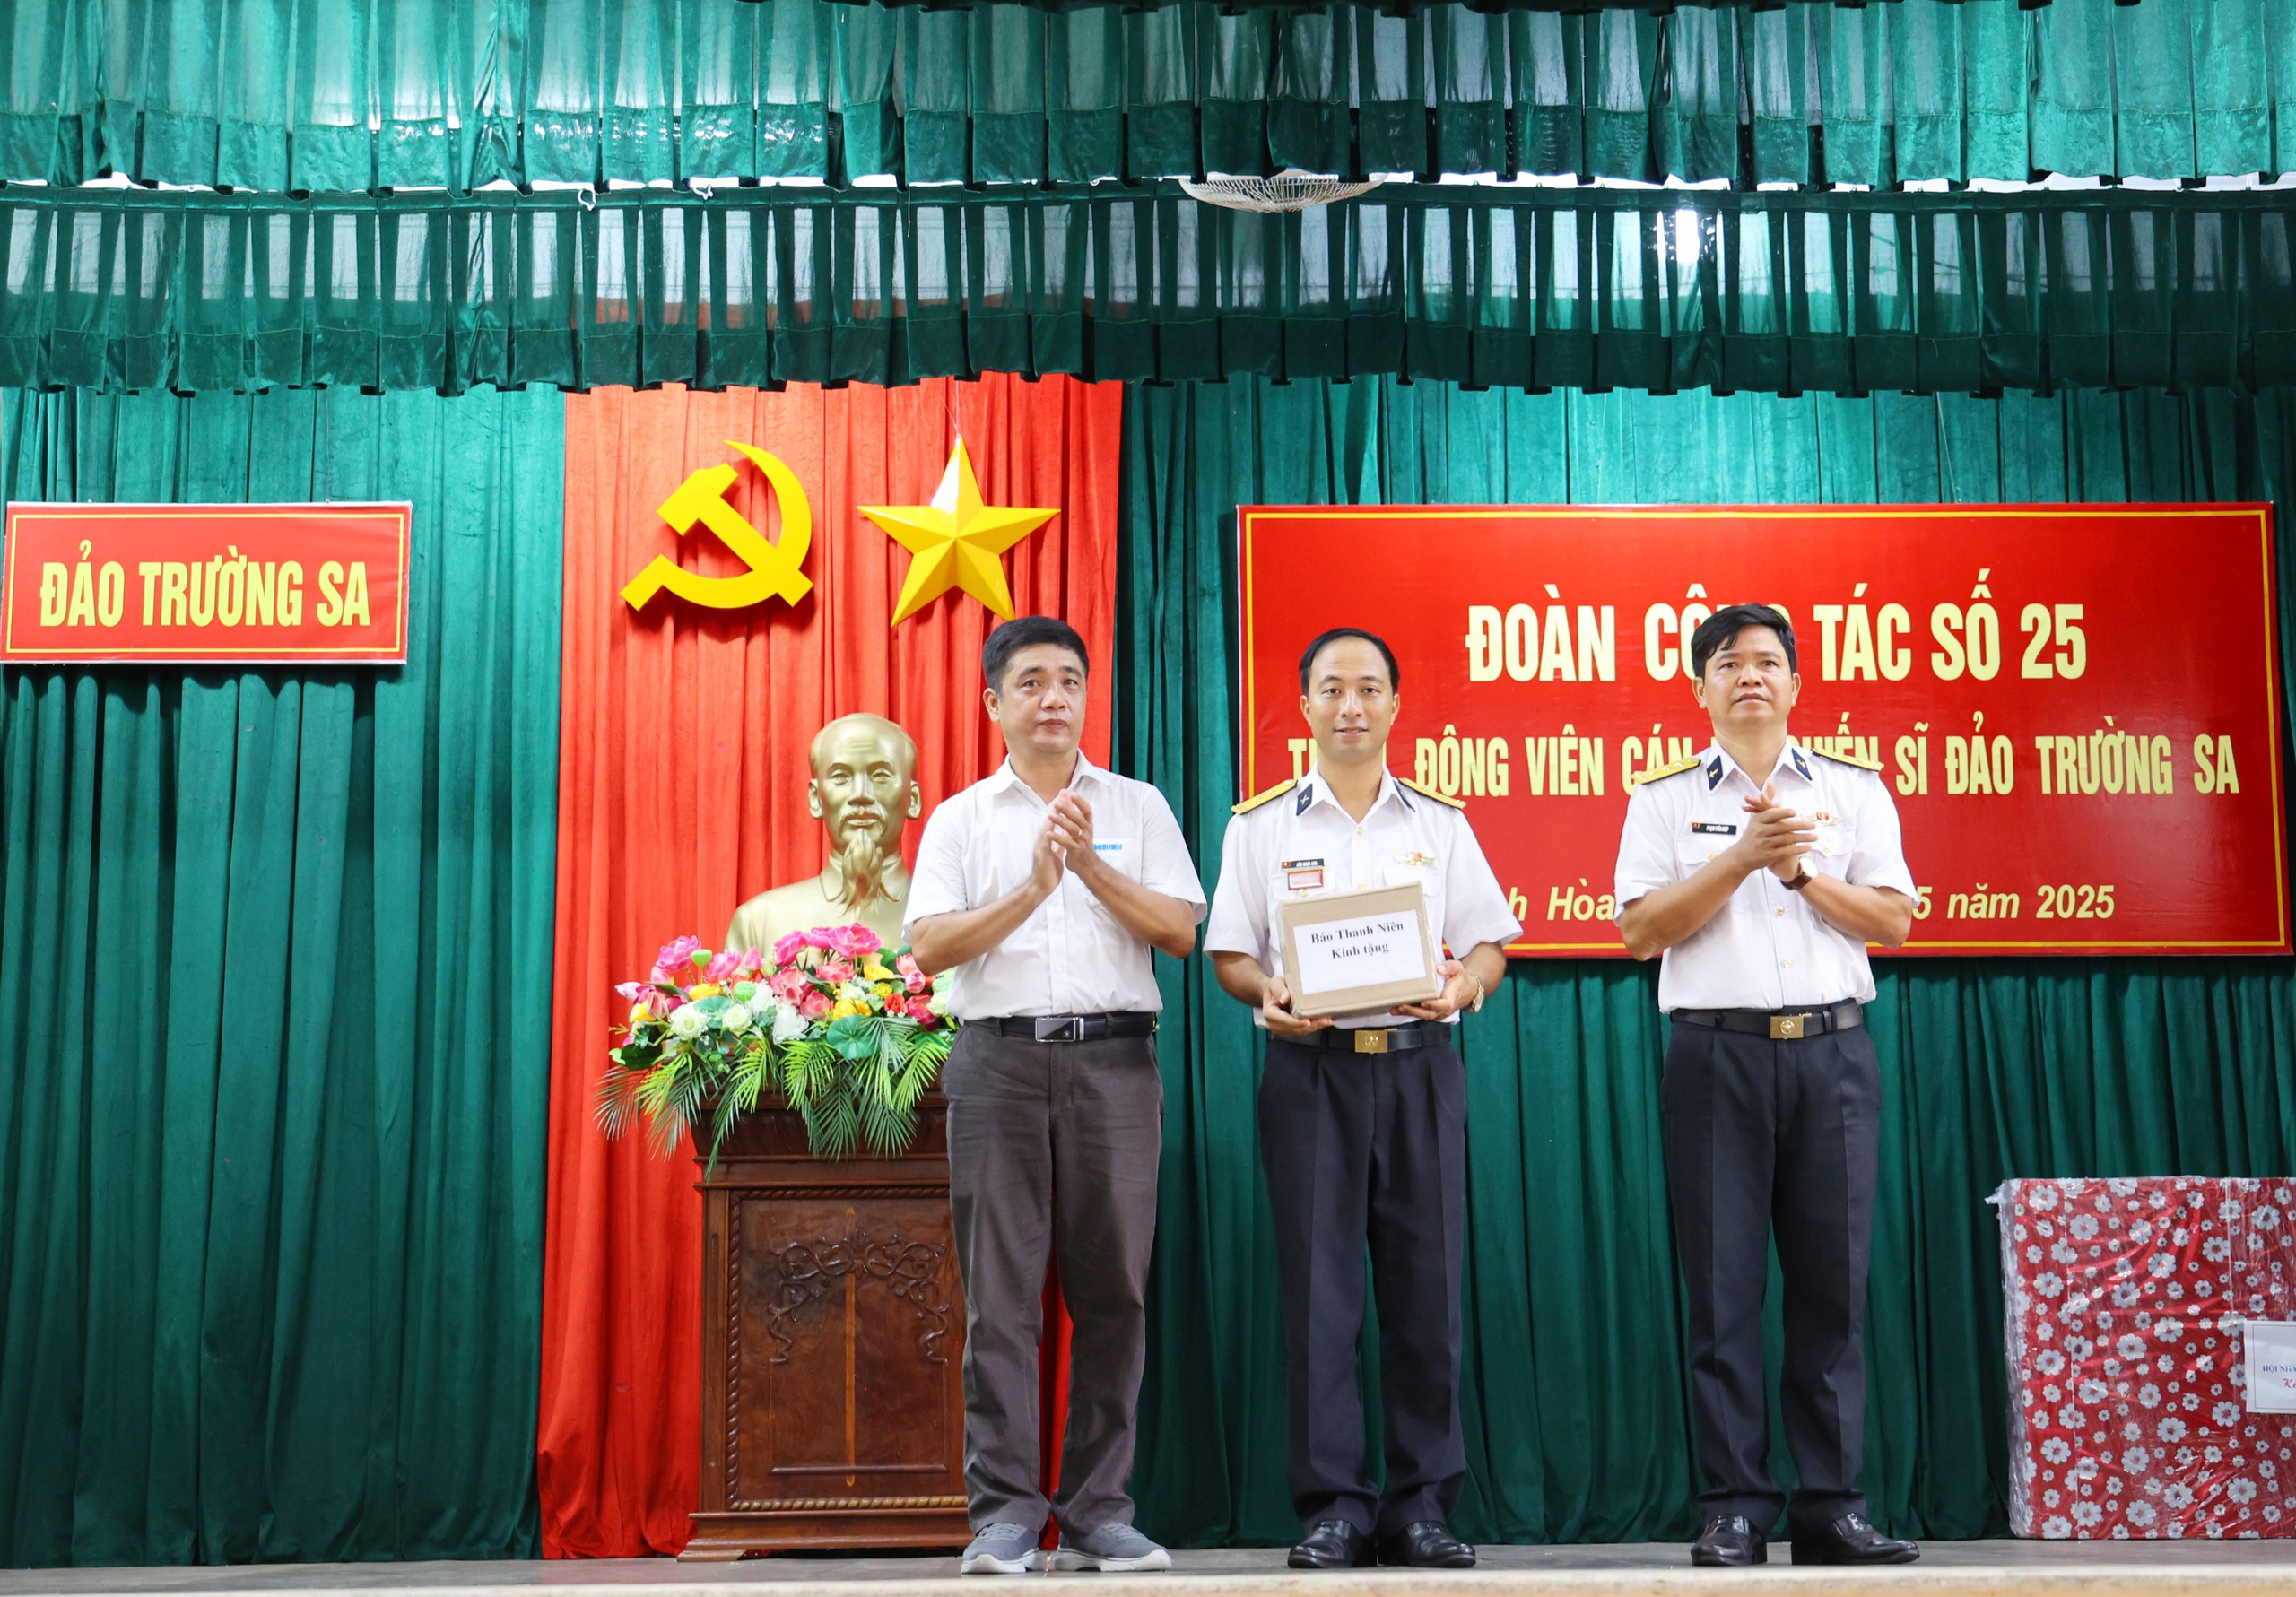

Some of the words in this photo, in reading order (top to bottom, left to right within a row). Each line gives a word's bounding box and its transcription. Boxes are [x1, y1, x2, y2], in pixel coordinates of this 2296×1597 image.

[39, 539, 126, 628] ĐẢO
[138, 544, 304, 628] TRƯỜNG
[317, 560, 371, 627] SA
[1465, 583, 1616, 682] ĐOÀN
[1644, 583, 1791, 681] CÔ
[1813, 582, 1912, 681] TÁC
[1930, 568, 2001, 681] SỐ
[2020, 603, 2087, 680] 25
[1525, 723, 1605, 796] VIÊN
[1894, 721, 1929, 796] SĨ
[1944, 710, 2014, 795] ĐẢO
[2035, 715, 2174, 795] TRƯỜNG
[2193, 733, 2240, 794] SA
[1947, 882, 2020, 919] năm
[2036, 884, 2115, 919] 2025
[1311, 932, 1334, 943] Báo
[1335, 925, 1374, 940] Thanh
[1378, 921, 1404, 934] Niên
[1332, 946, 1360, 959] Kính
[1363, 943, 1389, 956] tặng
